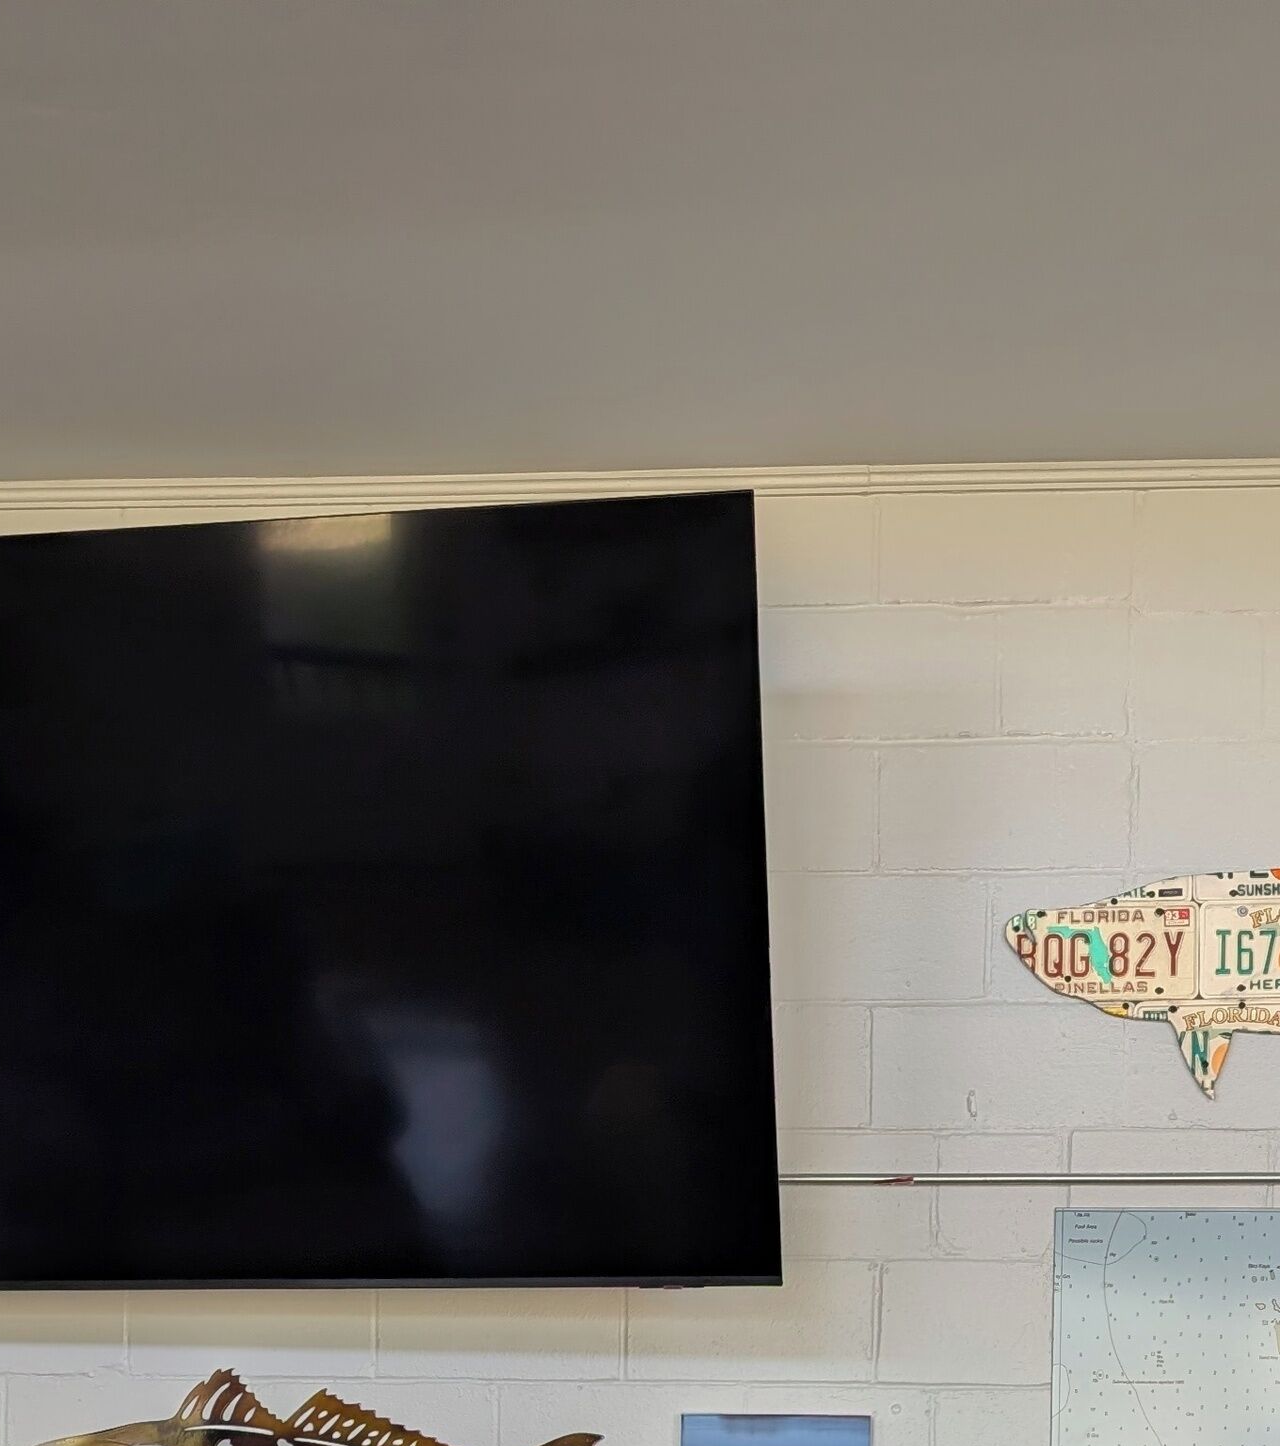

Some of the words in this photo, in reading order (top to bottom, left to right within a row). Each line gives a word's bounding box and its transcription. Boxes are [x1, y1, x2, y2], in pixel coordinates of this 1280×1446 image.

[1057, 911, 1145, 924] FLORIDA
[1165, 911, 1178, 920] 93
[1108, 931, 1184, 978] 82Y
[1215, 928, 1279, 975] I67
[1054, 981, 1149, 994] PINELLAS
